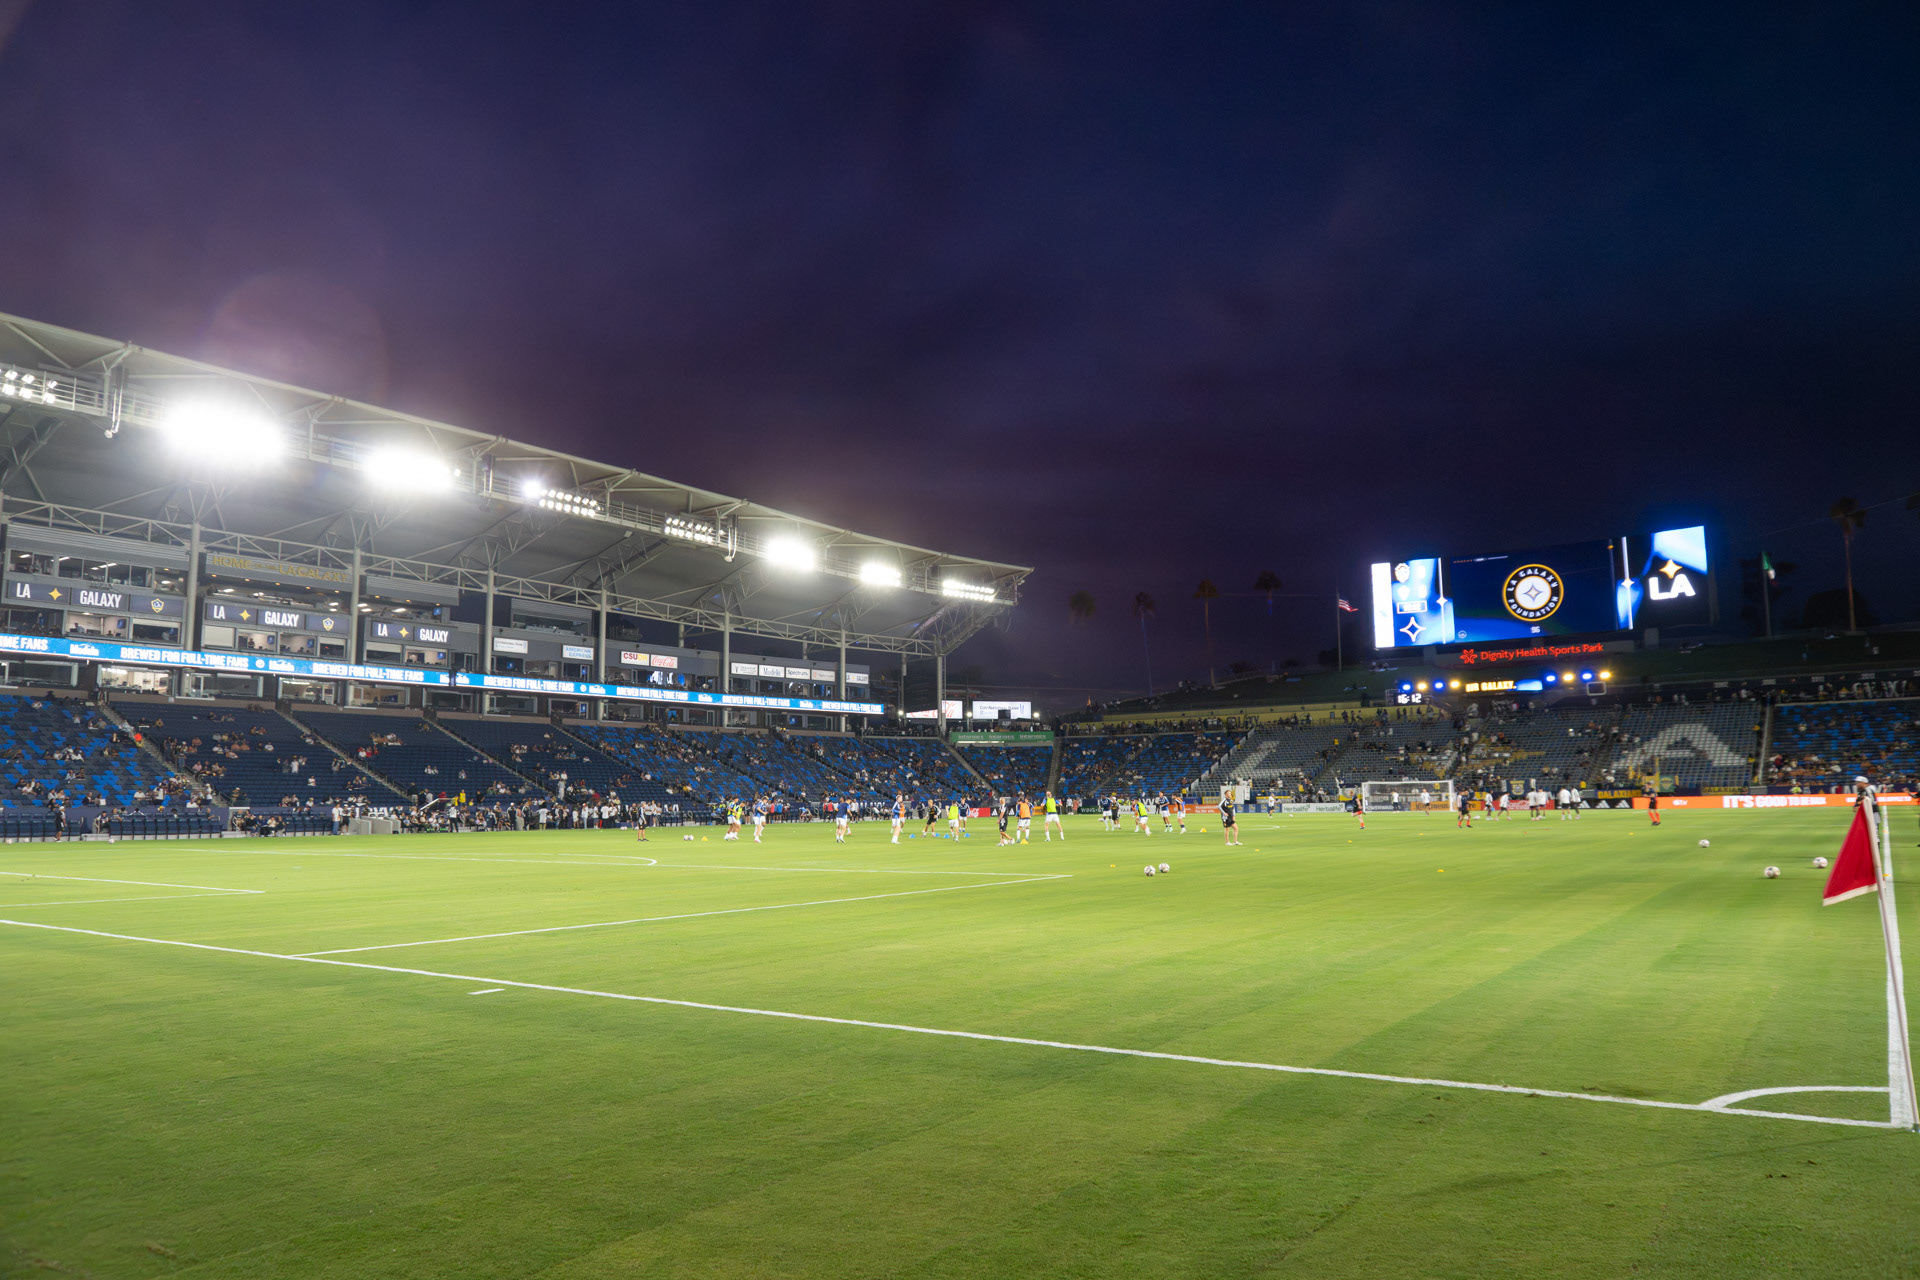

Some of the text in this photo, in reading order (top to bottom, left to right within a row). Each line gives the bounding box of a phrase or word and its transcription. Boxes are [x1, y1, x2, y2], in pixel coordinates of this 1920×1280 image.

[213, 555, 252, 570] HOME
[279, 565, 296, 576] LA
[297, 567, 349, 582] GALAXY
[1507, 568, 1558, 591] LA GALAXY
[1649, 573, 1696, 600] LA
[16, 582, 122, 608] LA GALAXY
[213, 605, 299, 627] LA GALAXY
[1507, 596, 1559, 618] FOUNDATION
[377, 624, 449, 642] LA GALAXY
[20, 637, 48, 651] FANS
[1480, 643, 1604, 662] Dignity Health Sports Park
[120, 647, 249, 668] BREWED FOR FULL-TIME FANS
[623, 652, 648, 661] CSUDH
[312, 662, 424, 681] BREWED FOR FULL-TIME FANS
[1722, 795, 1754, 808] IT'S
[1755, 795, 1788, 807] GOOD
